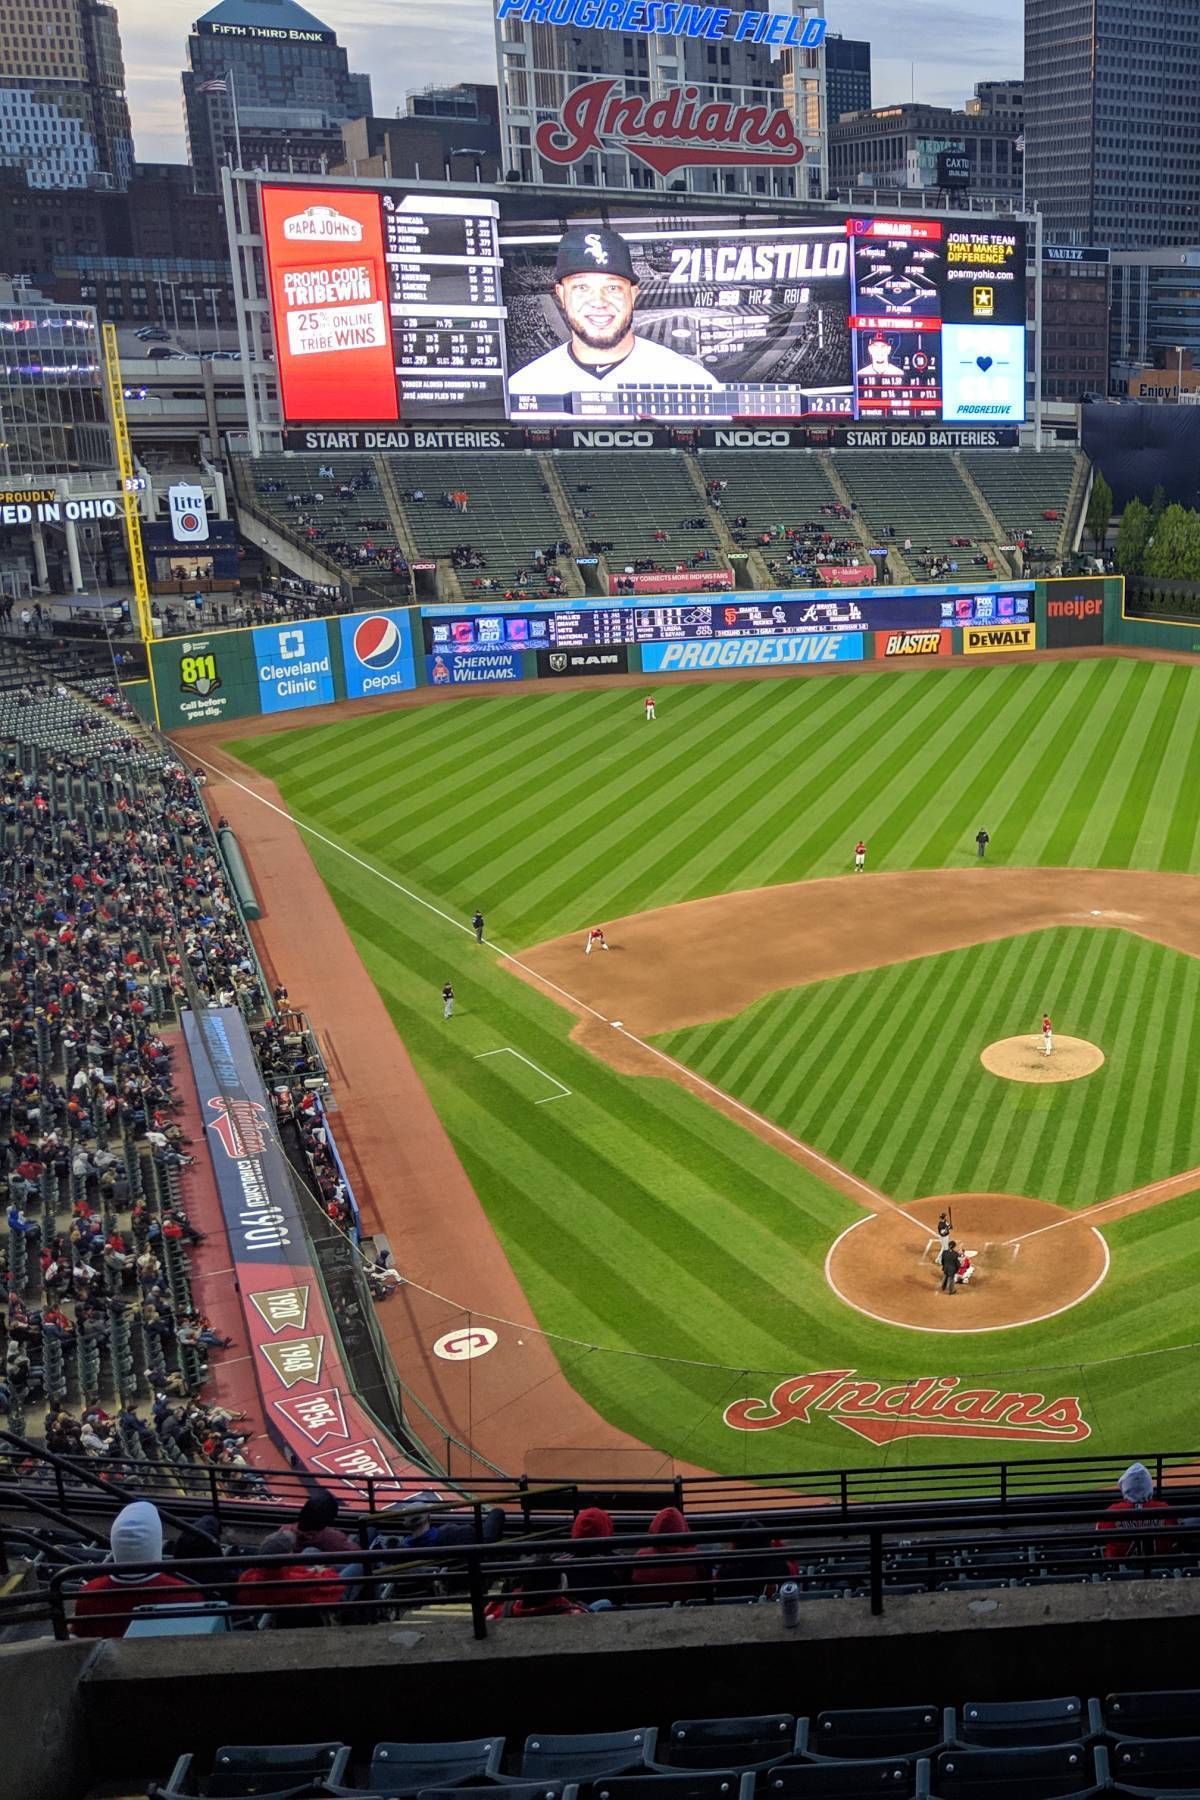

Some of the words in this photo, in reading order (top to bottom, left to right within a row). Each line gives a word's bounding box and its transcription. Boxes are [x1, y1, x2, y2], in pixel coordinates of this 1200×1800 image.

[212, 24, 246, 35] FIFTH
[249, 27, 287, 39] THIRD
[289, 30, 323, 42] BANK
[497, 0, 733, 40] PROGRESSIVE
[735, 12, 828, 49] FIELD
[536, 79, 805, 175] Indians
[289, 217, 317, 234] PAPA
[947, 233, 969, 243] JOIN
[971, 234, 989, 244] THE
[991, 235, 1016, 245] TEAM
[947, 243, 971, 252] THAT
[973, 244, 1005, 254] MAKES
[1006, 246, 1014, 254] A
[668, 248, 703, 285] 21
[714, 243, 849, 282] CASTILLO
[947, 252, 1007, 264] DIFFERENCE.
[284, 269, 330, 288] PROMO
[947, 270, 1014, 281] goarmyohio.com
[284, 278, 371, 306] TRIBEWIN
[694, 291, 714, 307] AVG
[749, 289, 763, 305] HR
[762, 288, 773, 305] 2
[783, 288, 800, 304] RBI
[333, 313, 373, 328] ONLINE
[301, 335, 333, 351] TRIBE
[335, 327, 376, 347] WINS
[1139, 383, 1171, 398] Enjoy
[957, 405, 1013, 415] PROGRESSIVE
[306, 432, 360, 449] START
[364, 432, 411, 448] DEAD
[414, 431, 505, 448] BATTERIES.
[573, 431, 654, 447] NOCO
[715, 431, 790, 447] NOCO
[846, 432, 889, 446] START
[891, 431, 927, 445] DEAD
[929, 430, 1000, 445] BATTERIES.
[37, 503, 60, 522] IN
[65, 499, 116, 520] OHIO
[173, 494, 202, 512] Lite
[1047, 596, 1103, 620] meijer
[478, 618, 499, 628] FOX
[481, 631, 500, 641] GO
[571, 654, 619, 666] RAM
[659, 635, 844, 670] PROGRESSIVE
[181, 655, 216, 683] 811
[260, 657, 329, 682] Cleveland
[453, 655, 513, 669] SHERWIN
[362, 671, 402, 692] pepsi
[453, 668, 517, 682] WILLIAMS.
[277, 676, 317, 697] Clinic
[180, 701, 197, 711] Call
[197, 698, 227, 708] before
[187, 710, 204, 720] you
[205, 706, 222, 717] dig.
[239, 1205, 291, 1250] 1901
[266, 1291, 300, 1319] 1920
[443, 1333, 489, 1354] C
[279, 1343, 314, 1372] 1948
[294, 1396, 338, 1429] 1954
[723, 1369, 1092, 1446] Indians
